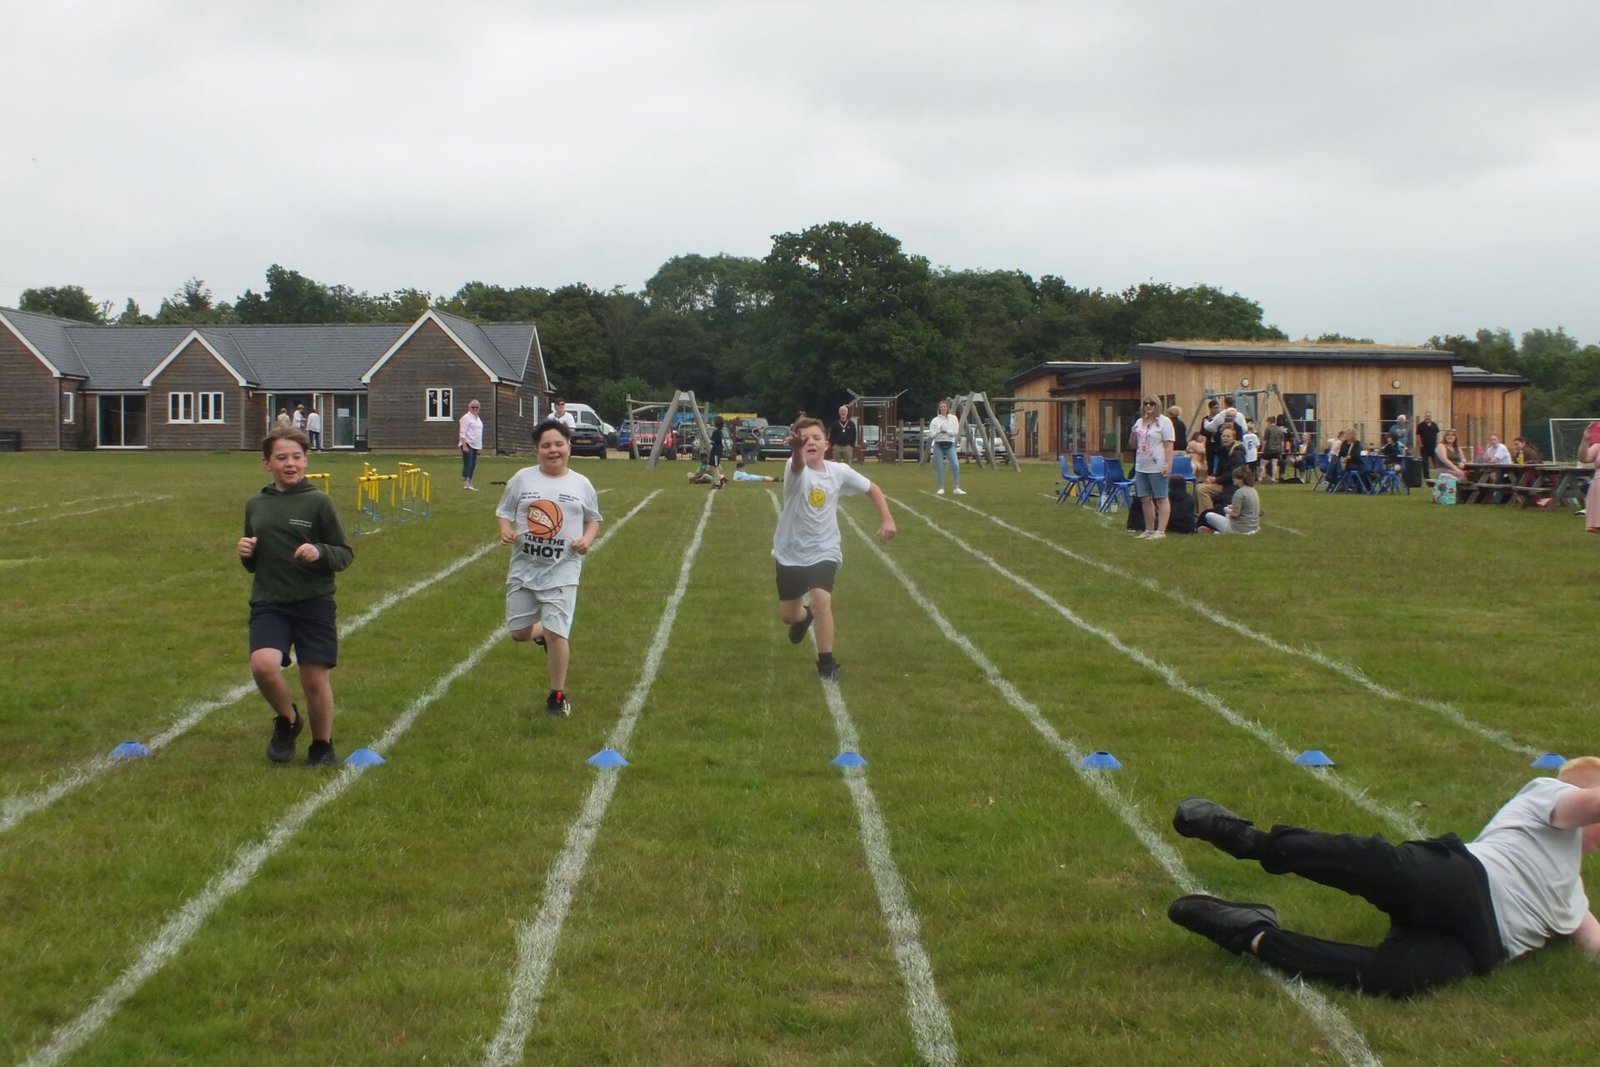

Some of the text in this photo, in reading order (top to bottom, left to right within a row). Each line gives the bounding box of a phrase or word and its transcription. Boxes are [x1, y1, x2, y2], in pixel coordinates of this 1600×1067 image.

[524, 533, 566, 546] TAKE THE
[523, 542, 564, 559] SHOT
